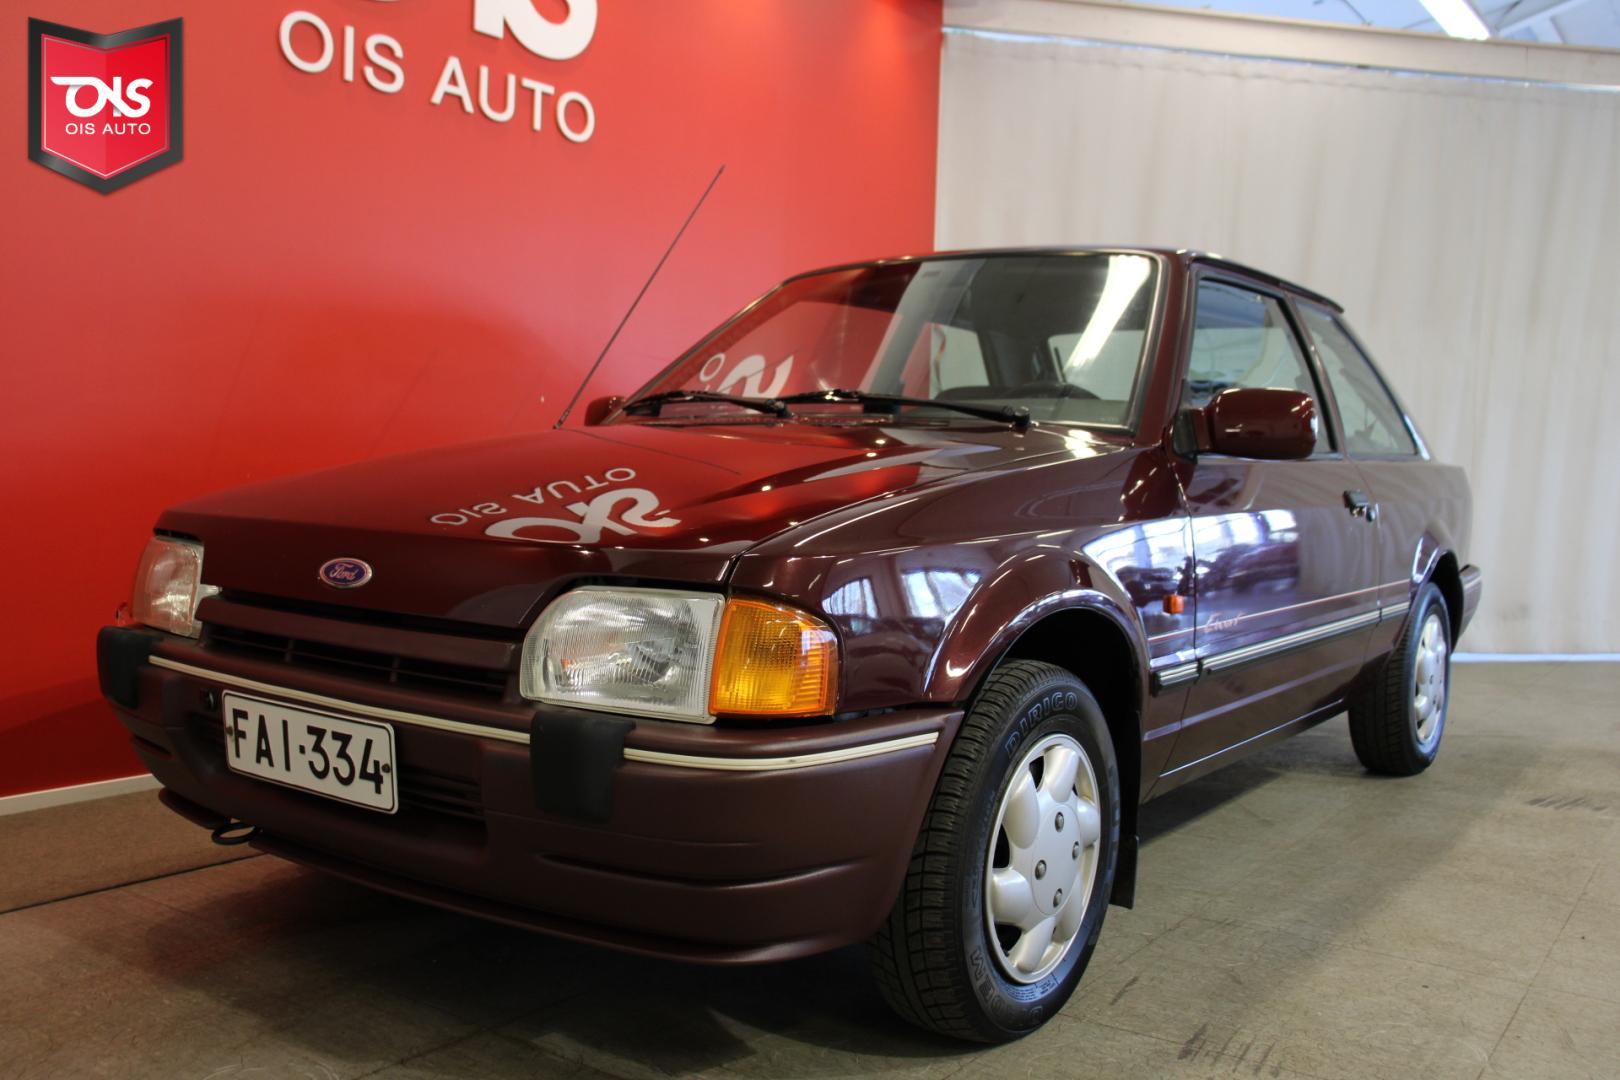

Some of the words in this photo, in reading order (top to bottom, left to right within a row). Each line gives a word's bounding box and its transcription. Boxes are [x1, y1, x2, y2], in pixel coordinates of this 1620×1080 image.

[279, 10, 405, 93] OIS
[430, 56, 596, 143] AUTO
[232, 708, 384, 795] FAI-334
[1005, 691, 1078, 759] DIRIGO
